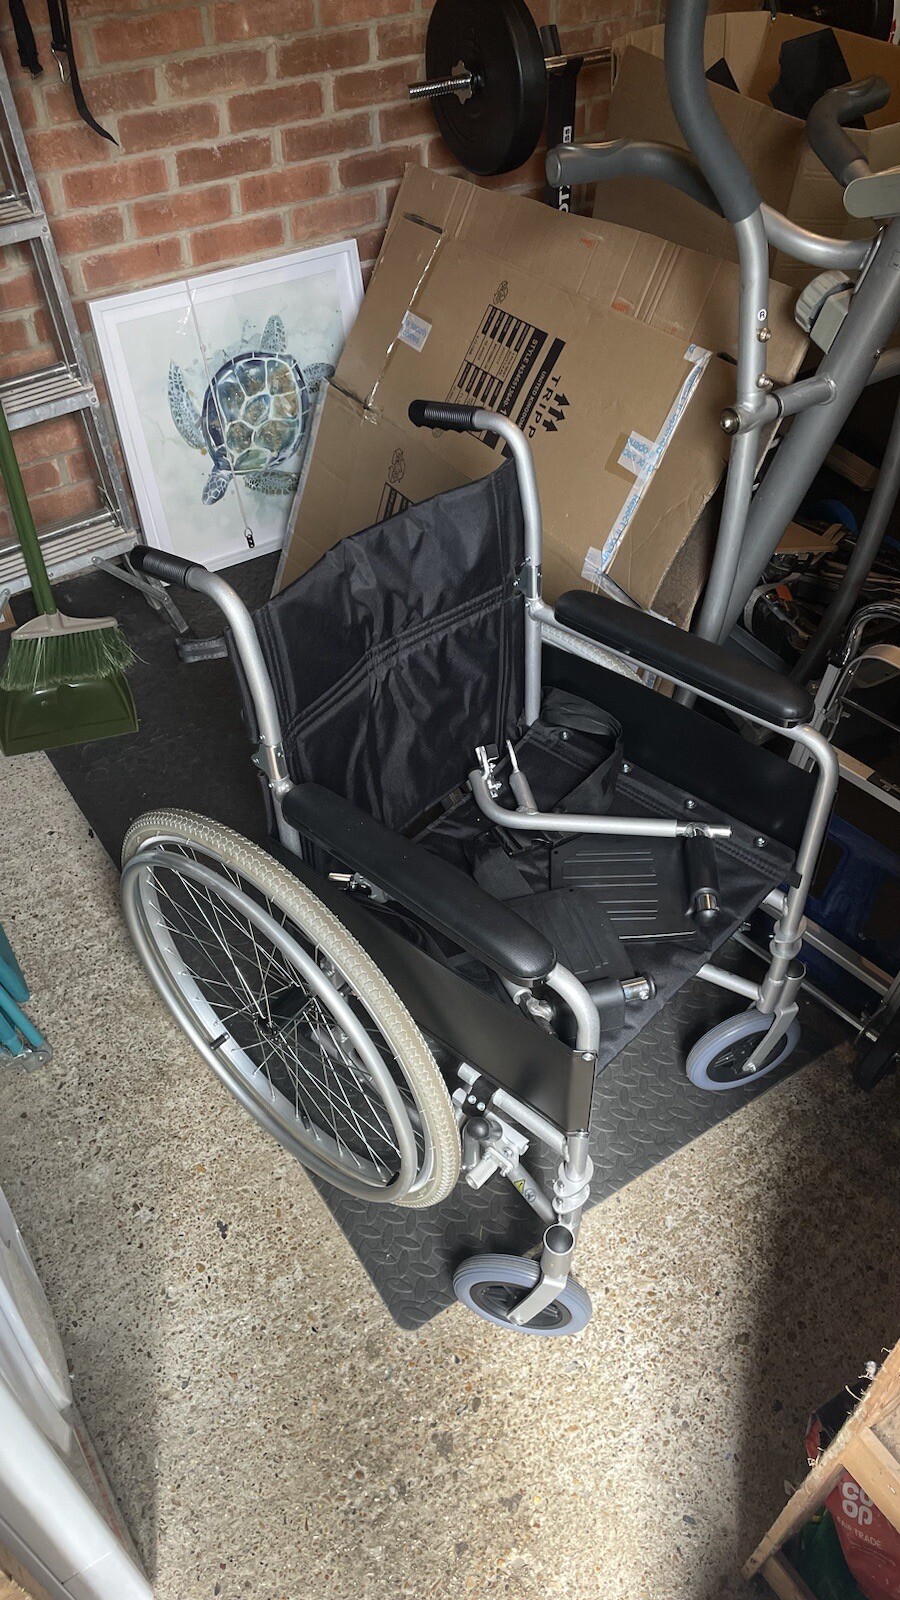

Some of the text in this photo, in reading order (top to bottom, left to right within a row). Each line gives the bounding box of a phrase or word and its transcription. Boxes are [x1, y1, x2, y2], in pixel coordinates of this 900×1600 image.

[522, 338, 539, 364] STYLE
[516, 371, 547, 428] UNITED KINGDOM
[528, 374, 562, 438] TRIPP
[620, 493, 640, 527] Reject
[853, 1528, 883, 1549] TRADE
